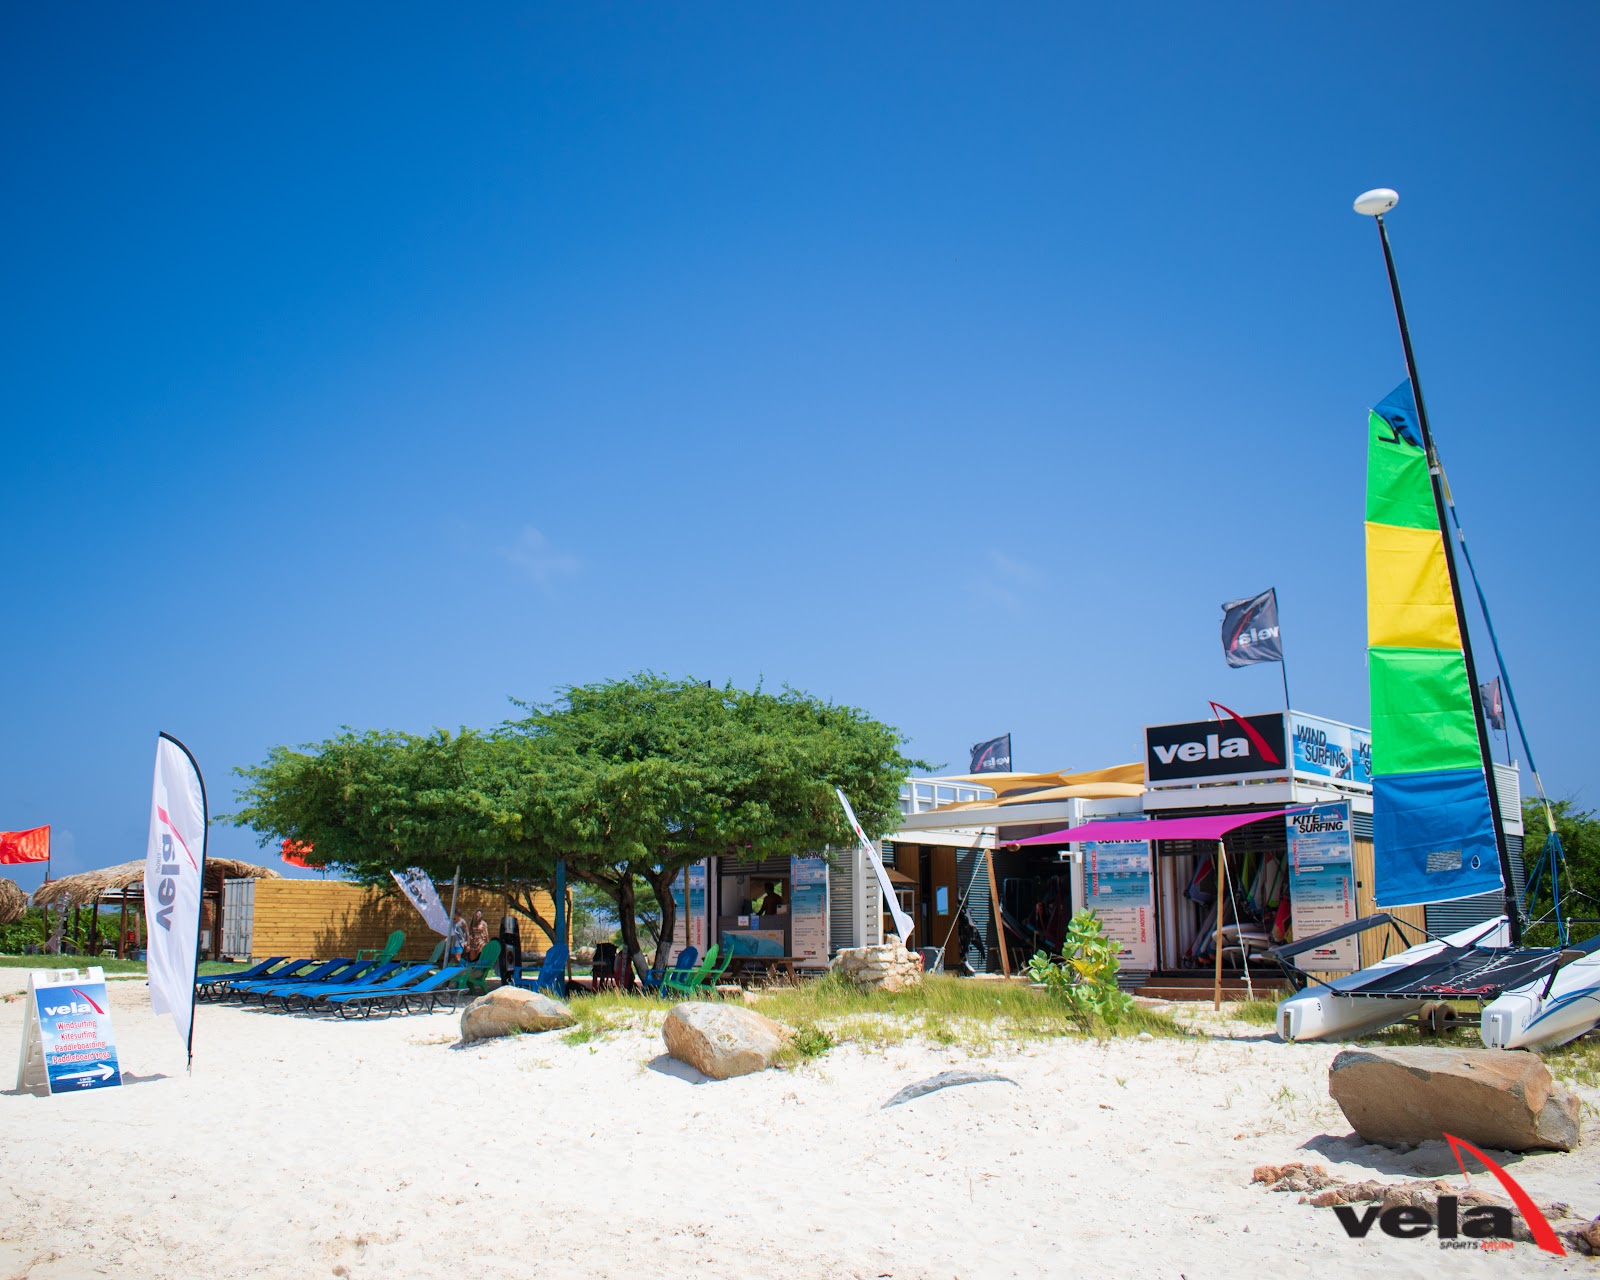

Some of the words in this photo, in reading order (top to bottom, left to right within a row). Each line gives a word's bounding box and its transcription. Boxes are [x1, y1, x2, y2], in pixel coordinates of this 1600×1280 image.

[1297, 724, 1327, 747] WIND
[1152, 734, 1250, 764] vela
[1305, 744, 1346, 769] SURFING
[1292, 814, 1320, 825] KITE
[1299, 821, 1343, 834] SURFING
[44, 1002, 91, 1016] vela
[1317, 1002, 1321, 1011] 3
[57, 1020, 97, 1030] Windsurfing
[60, 1031, 97, 1040] Kitesurfing
[55, 1041, 106, 1052] Paddleboarding
[52, 1053, 95, 1063] Paddleboard
[95, 1051, 111, 1060] Yoga
